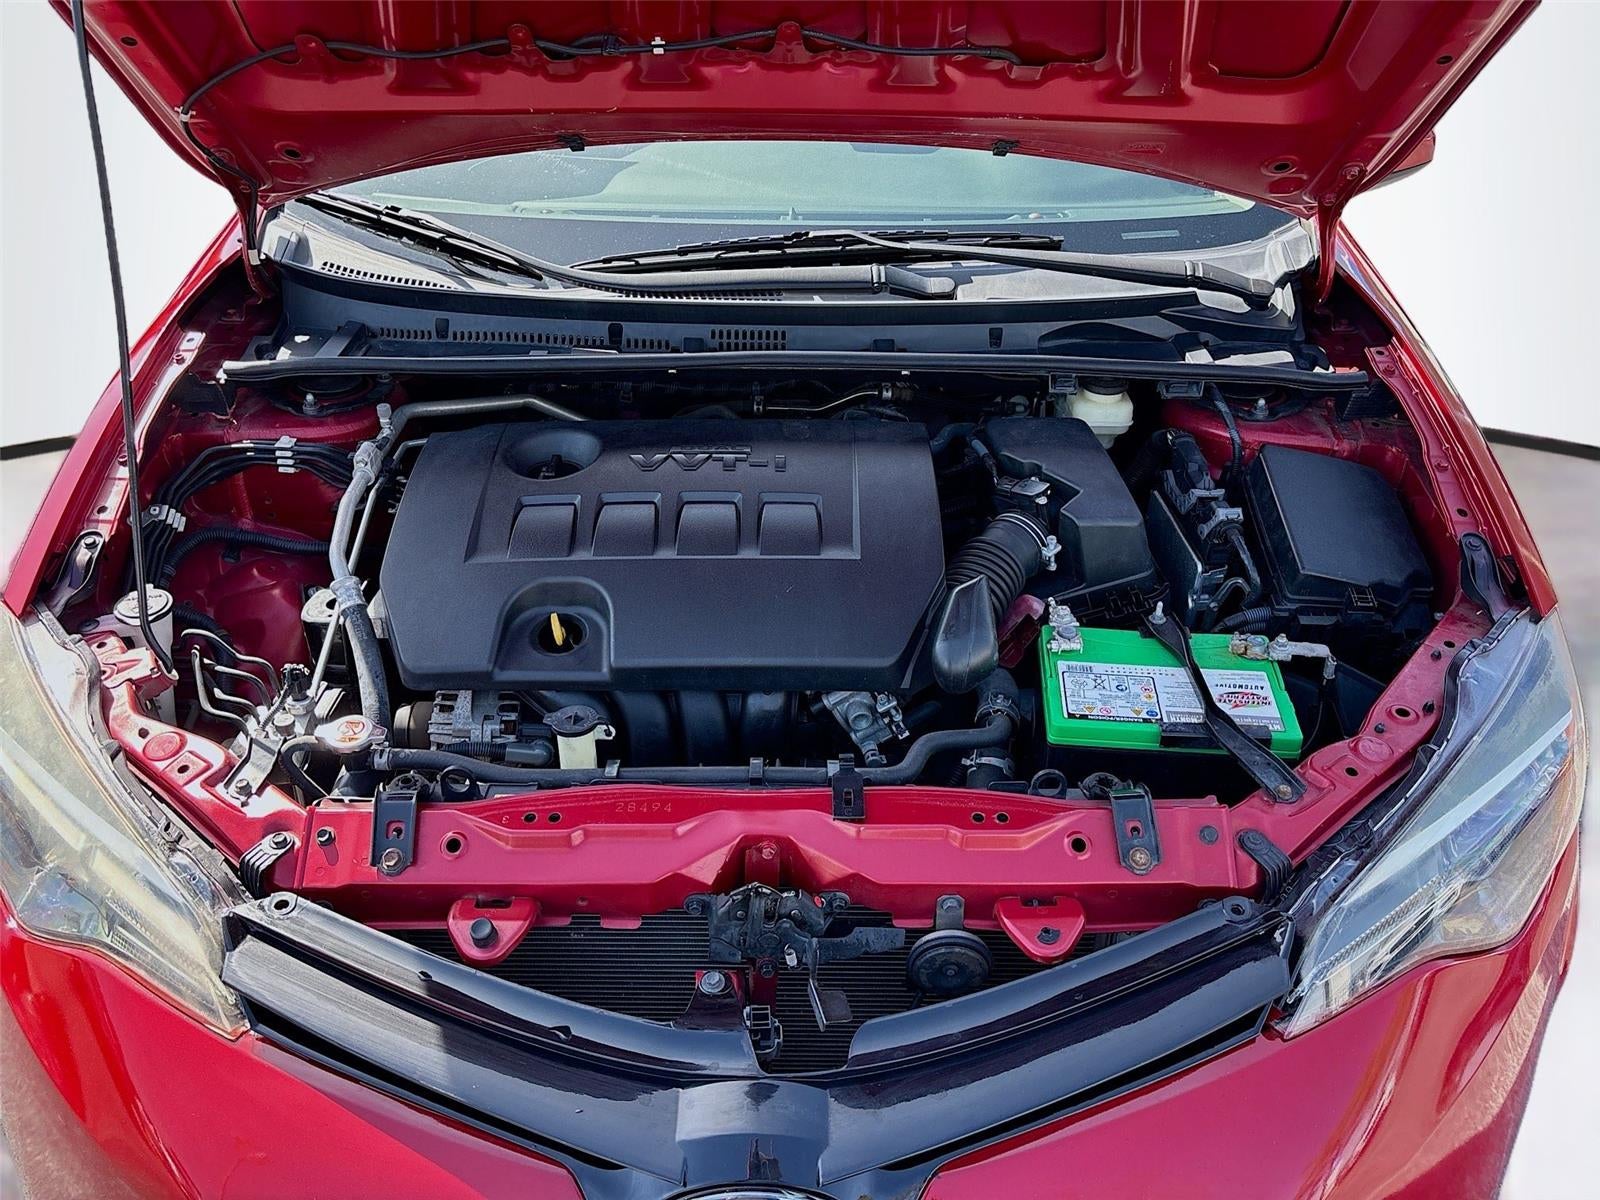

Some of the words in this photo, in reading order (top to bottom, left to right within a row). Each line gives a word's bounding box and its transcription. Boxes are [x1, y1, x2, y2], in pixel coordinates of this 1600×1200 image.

[1215, 683, 1264, 691] AUTOMOTIVE
[1216, 698, 1271, 706] INTERSTATE
[615, 802, 672, 813] 28494
